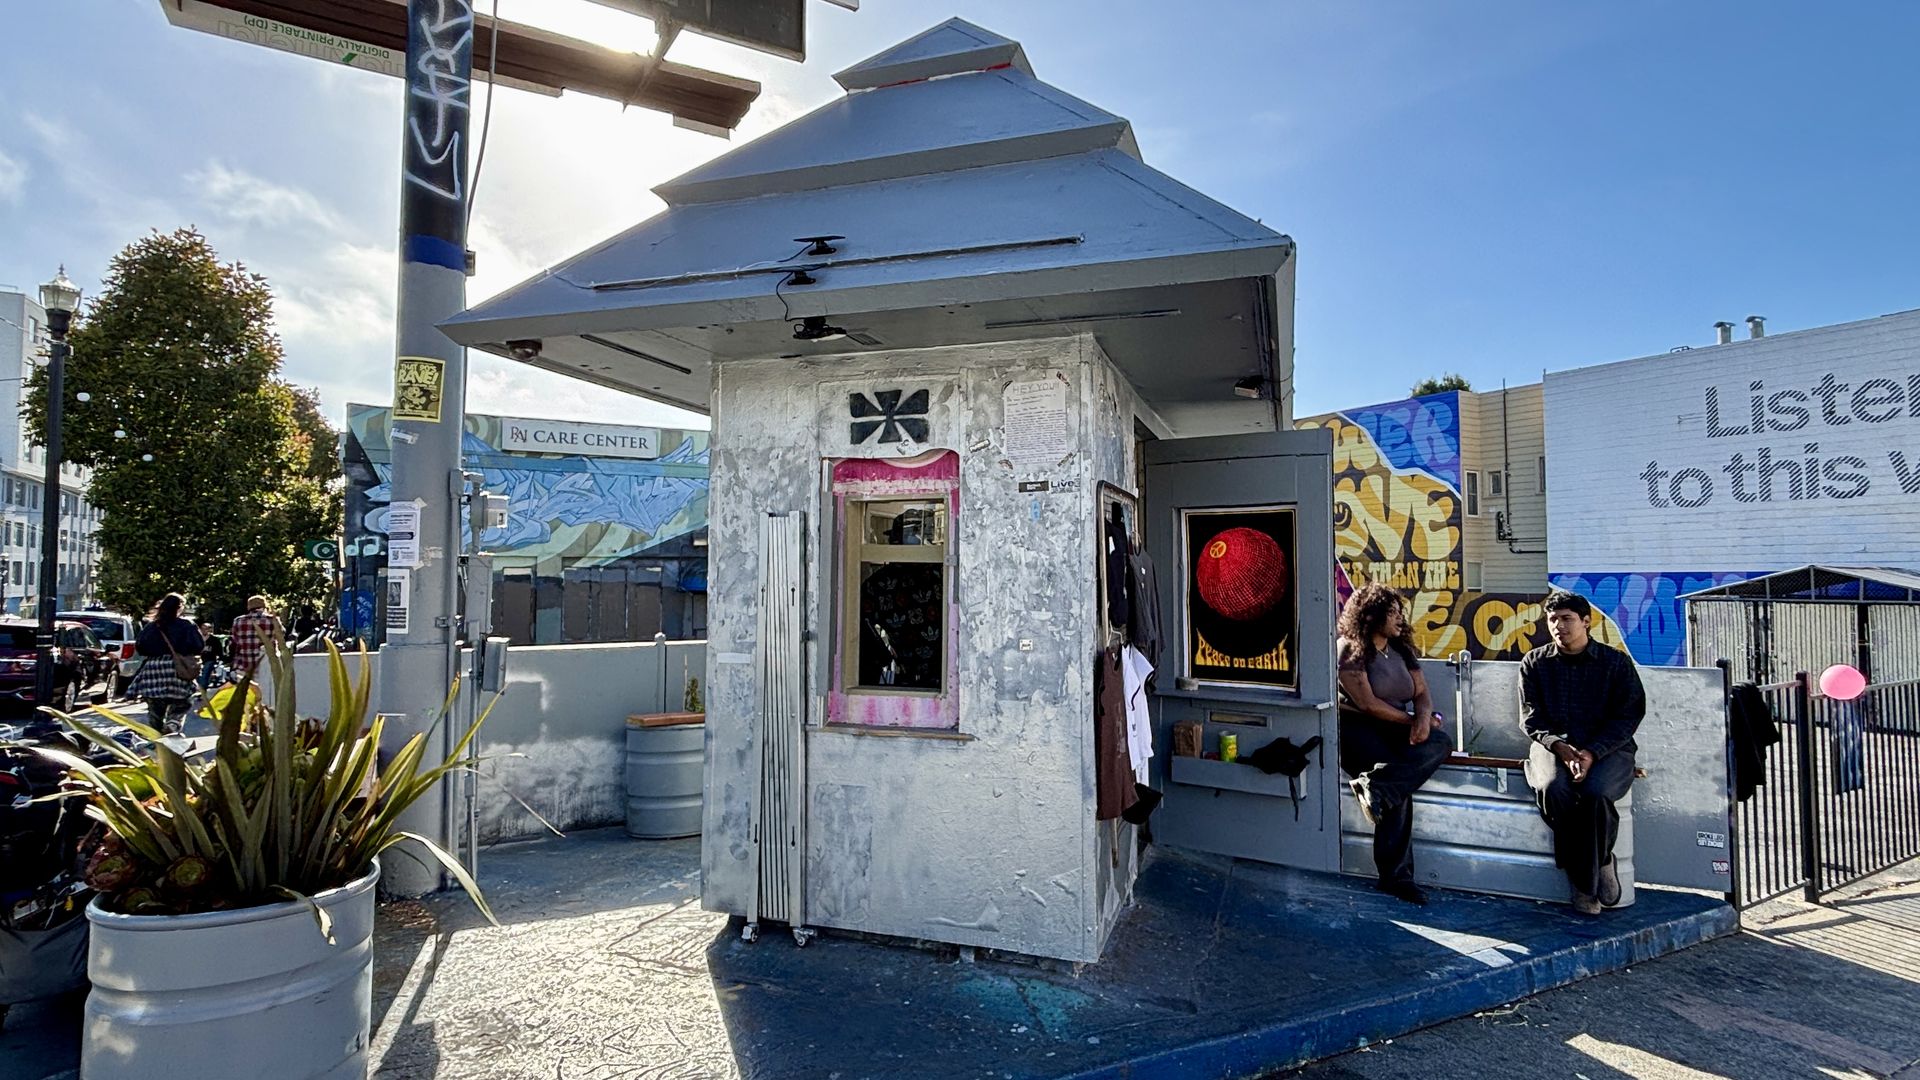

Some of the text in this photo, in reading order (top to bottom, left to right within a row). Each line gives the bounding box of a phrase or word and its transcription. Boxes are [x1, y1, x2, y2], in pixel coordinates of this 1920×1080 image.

[243, 14, 390, 60] DIGITALLY PRINTABLE (DP)
[398, 368, 440, 385] RAVE!
[1012, 382, 1034, 395] HEY
[533, 429, 579, 445] CARE
[583, 433, 649, 450] CENTER
[1639, 460, 1714, 508] to
[1722, 442, 1871, 503] this
[1368, 561, 1420, 590] THAN
[1422, 560, 1460, 590] THE
[1473, 599, 1542, 655] OF
